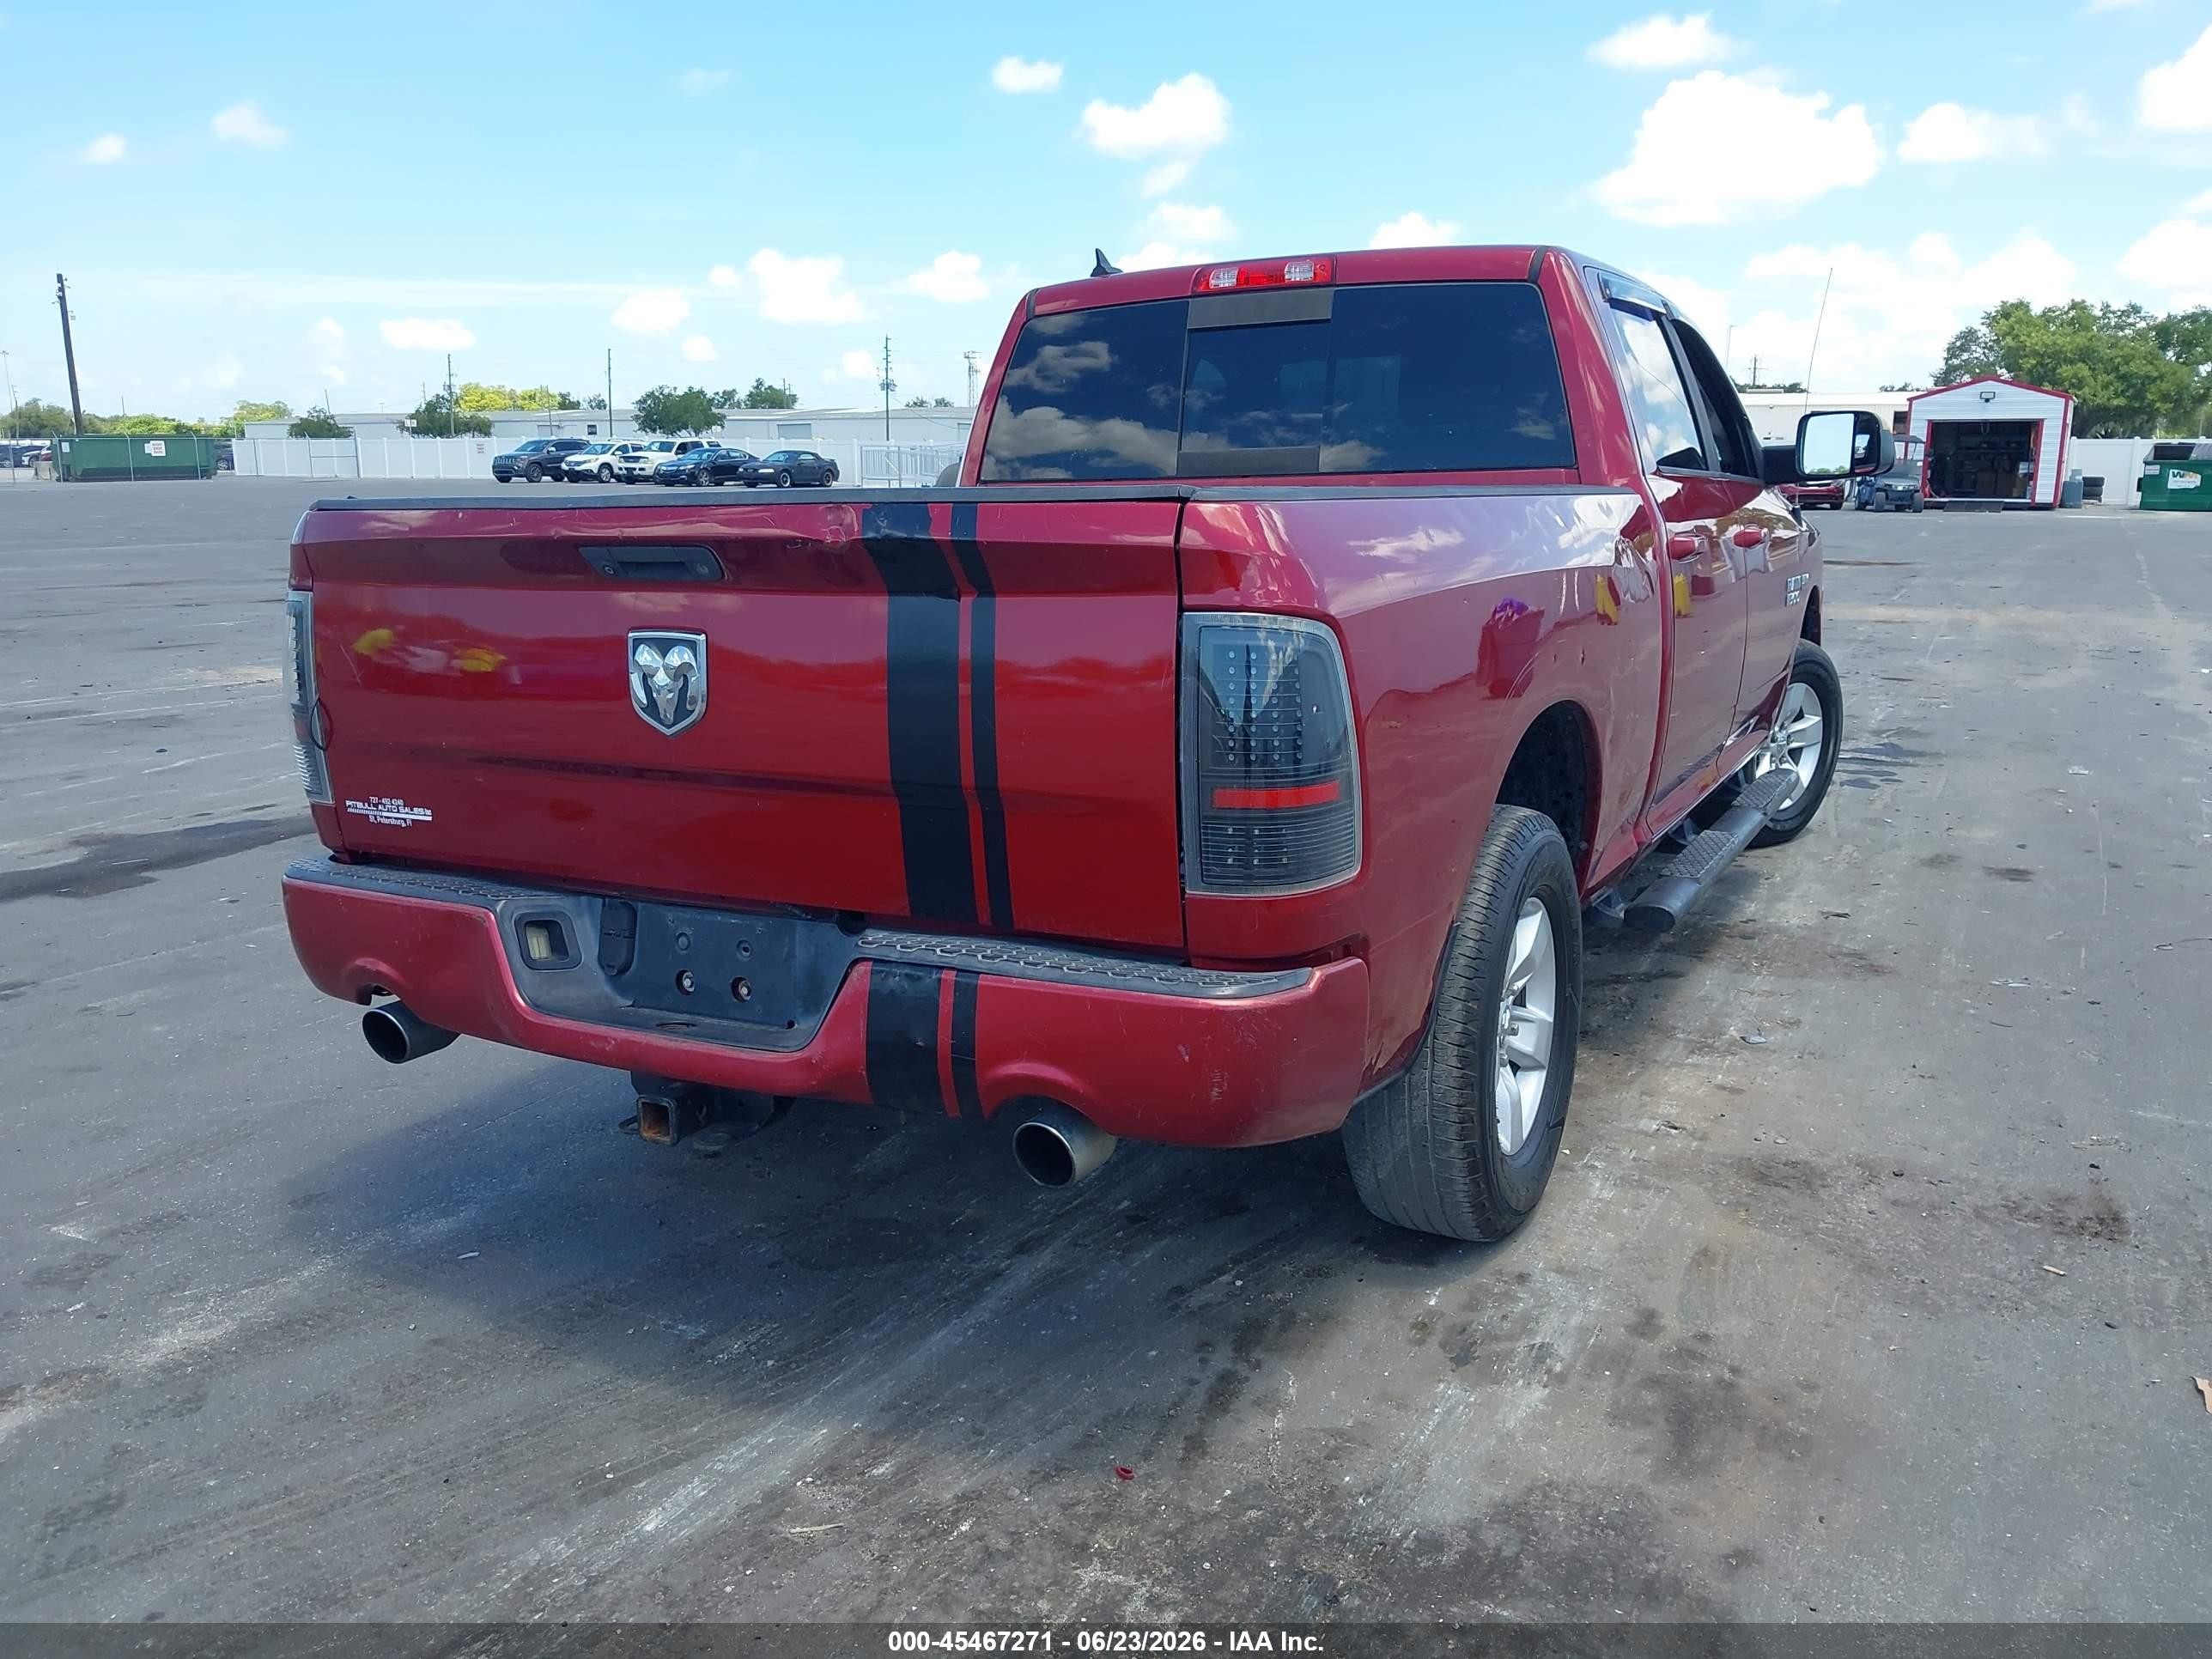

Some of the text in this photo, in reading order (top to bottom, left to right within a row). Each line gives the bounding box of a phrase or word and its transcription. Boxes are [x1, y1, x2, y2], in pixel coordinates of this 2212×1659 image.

[345, 800, 377, 810] PITBULL
[378, 804, 398, 812] AUTO
[398, 806, 425, 815] SALES
